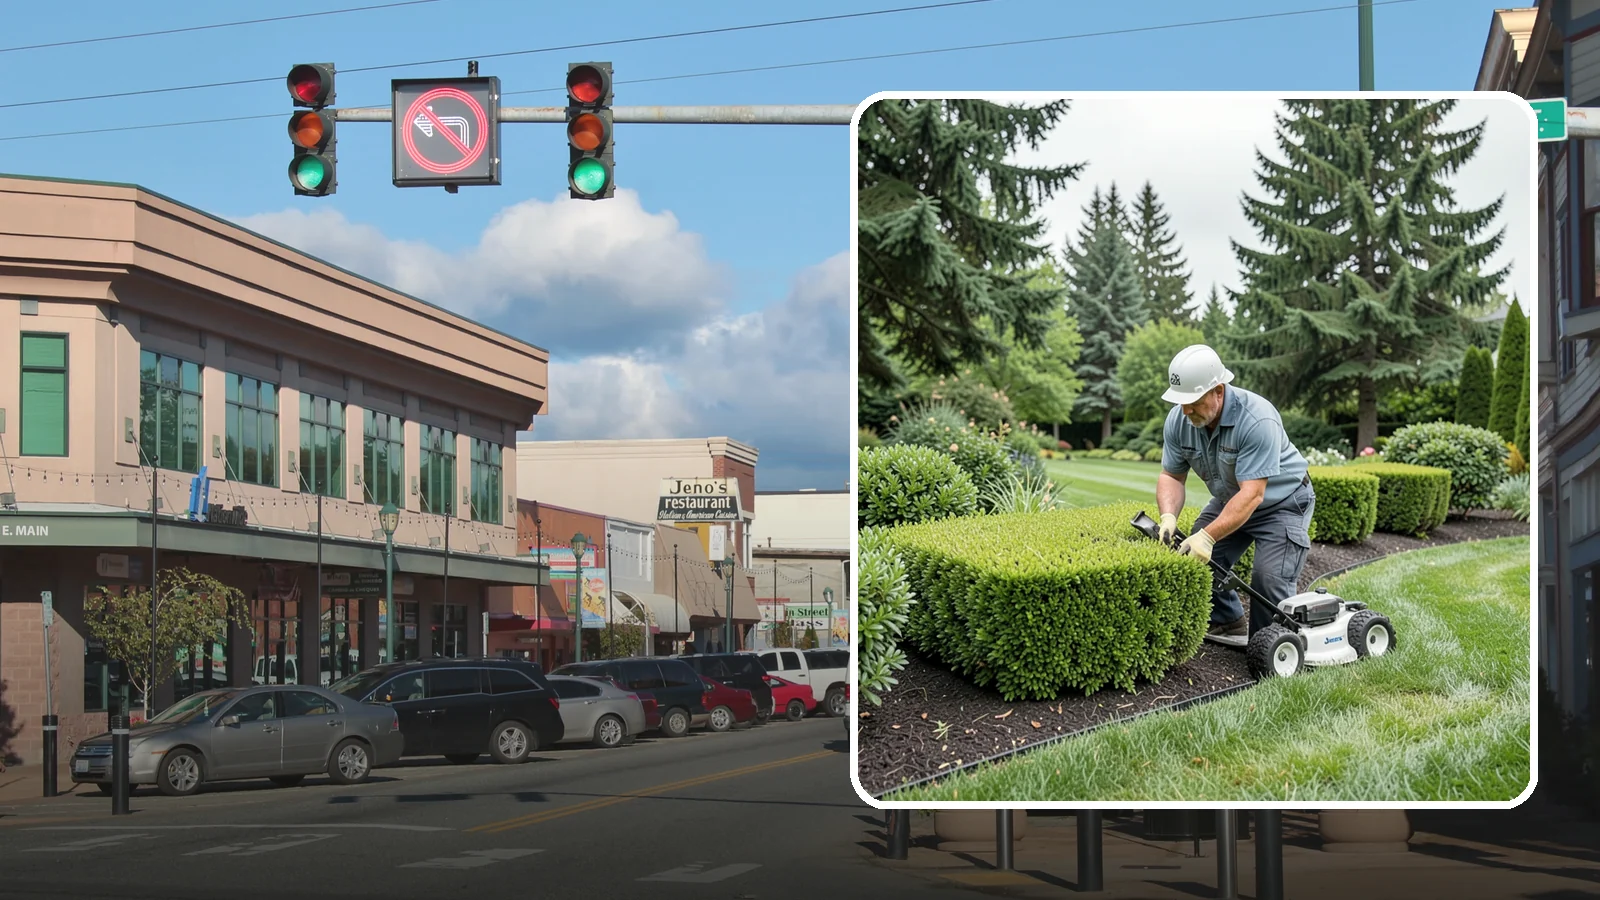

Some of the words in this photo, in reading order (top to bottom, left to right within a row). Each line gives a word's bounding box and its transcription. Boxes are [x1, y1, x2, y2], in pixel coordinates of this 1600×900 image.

[670, 480, 727, 494] Jeno's
[665, 496, 731, 508] restaurant
[659, 510, 682, 519] Italian
[686, 510, 715, 520] American
[715, 510, 738, 519] Cuisine
[2, 525, 13, 536] E.
[15, 525, 49, 536] MAIN
[785, 607, 795, 616] in
[797, 607, 828, 617] Street
